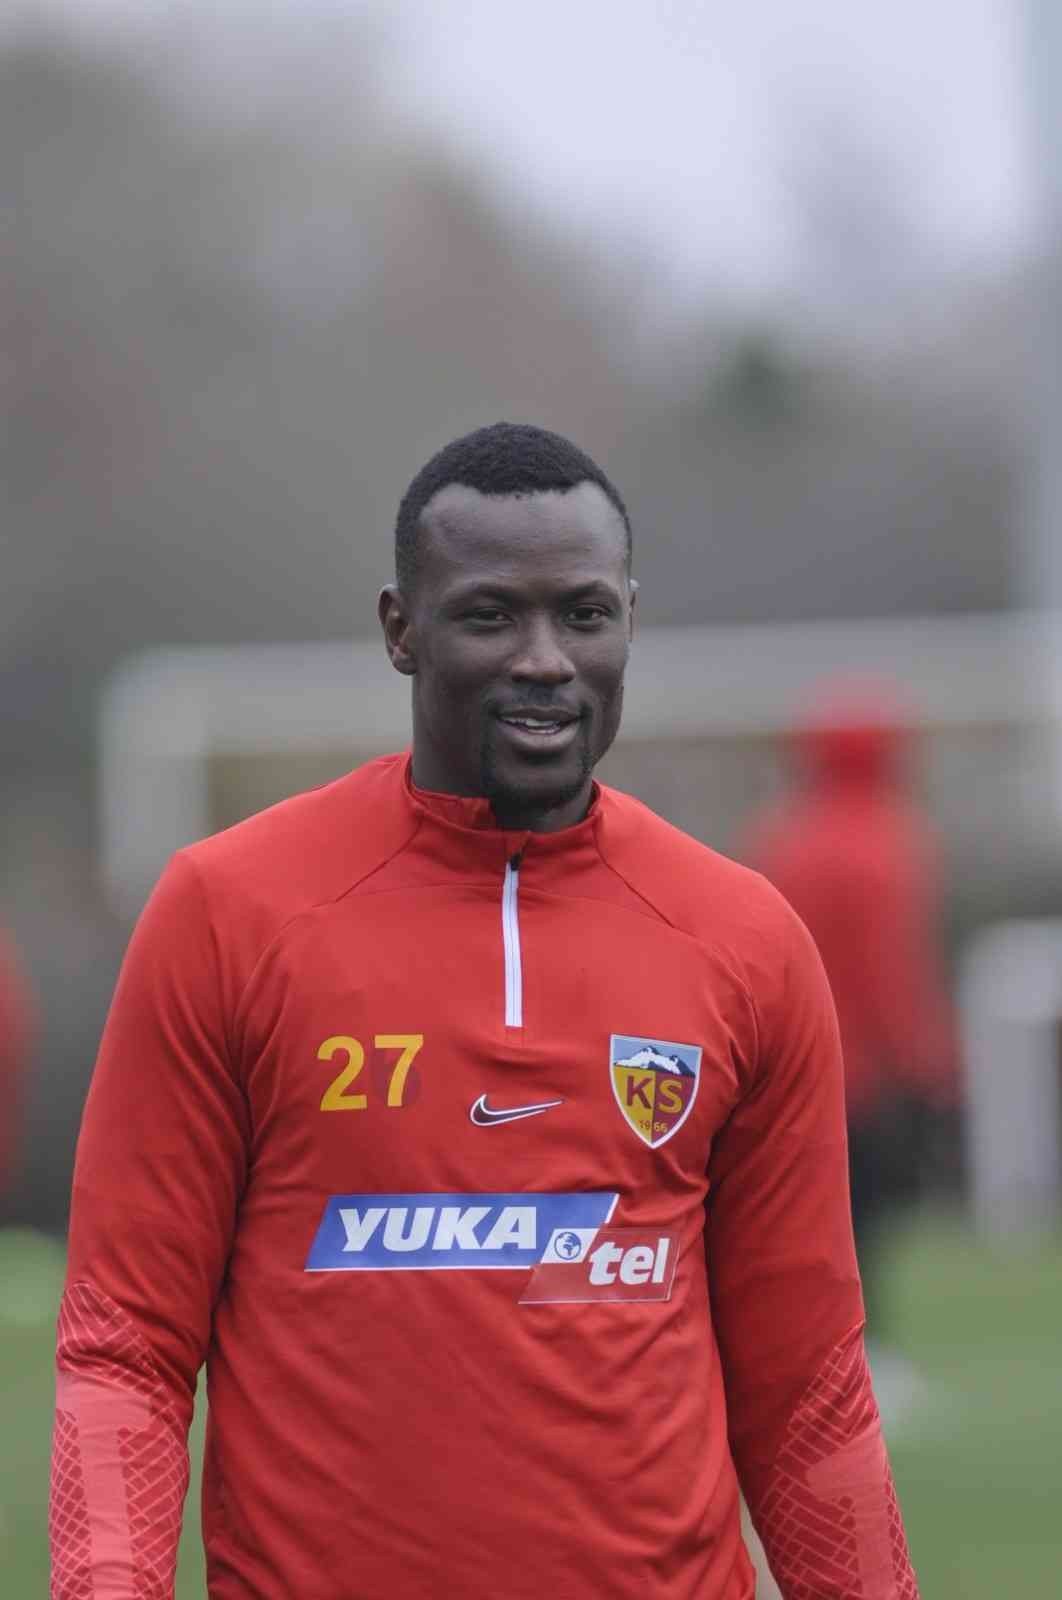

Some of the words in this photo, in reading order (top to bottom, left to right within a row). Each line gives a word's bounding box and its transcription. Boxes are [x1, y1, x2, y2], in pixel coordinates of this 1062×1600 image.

[317, 1034, 424, 1112] 27
[626, 1074, 684, 1114] KS
[339, 1206, 537, 1252] YUKA
[588, 1238, 670, 1286] tel
